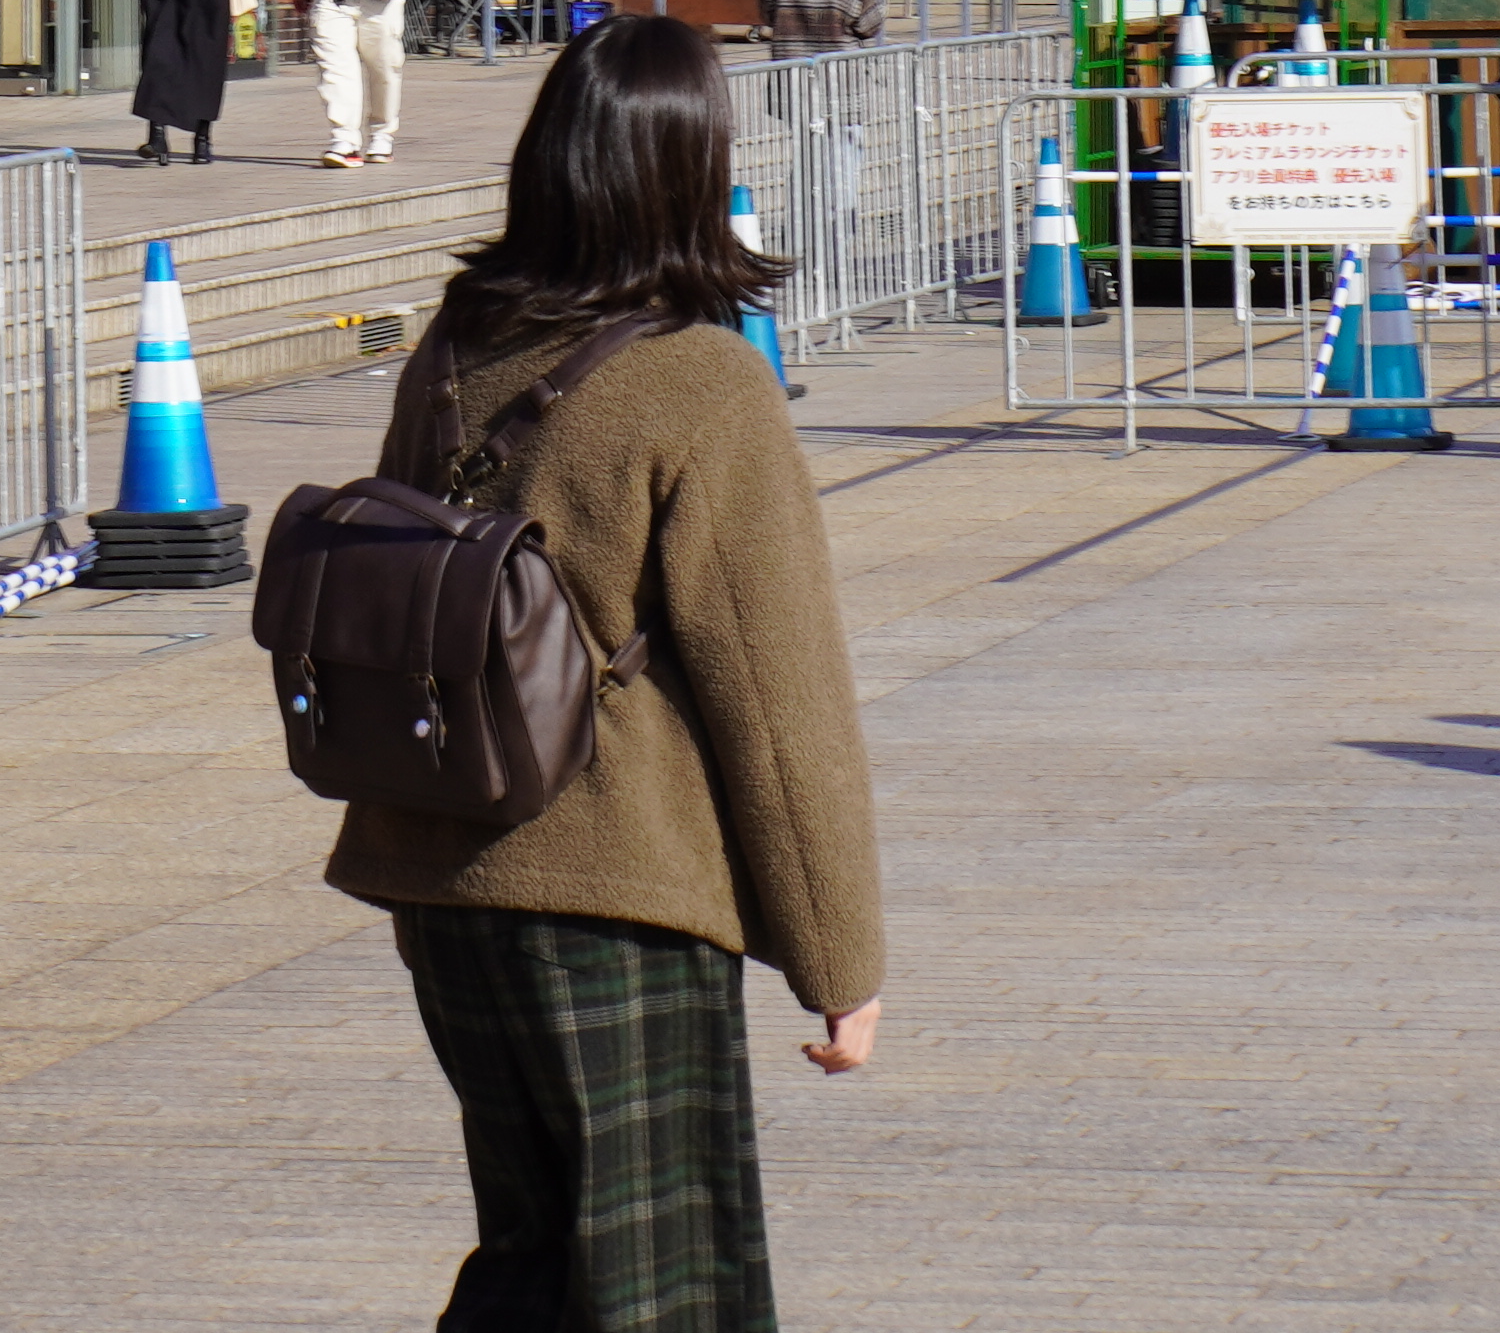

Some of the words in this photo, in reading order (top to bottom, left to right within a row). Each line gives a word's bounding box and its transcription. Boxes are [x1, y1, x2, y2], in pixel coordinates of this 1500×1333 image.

[1209, 121, 1331, 138] 優先入場チケット
[1210, 144, 1409, 160] プレミアムラウンジチケット
[1227, 193, 1392, 210] をお持ちの方はこちら
